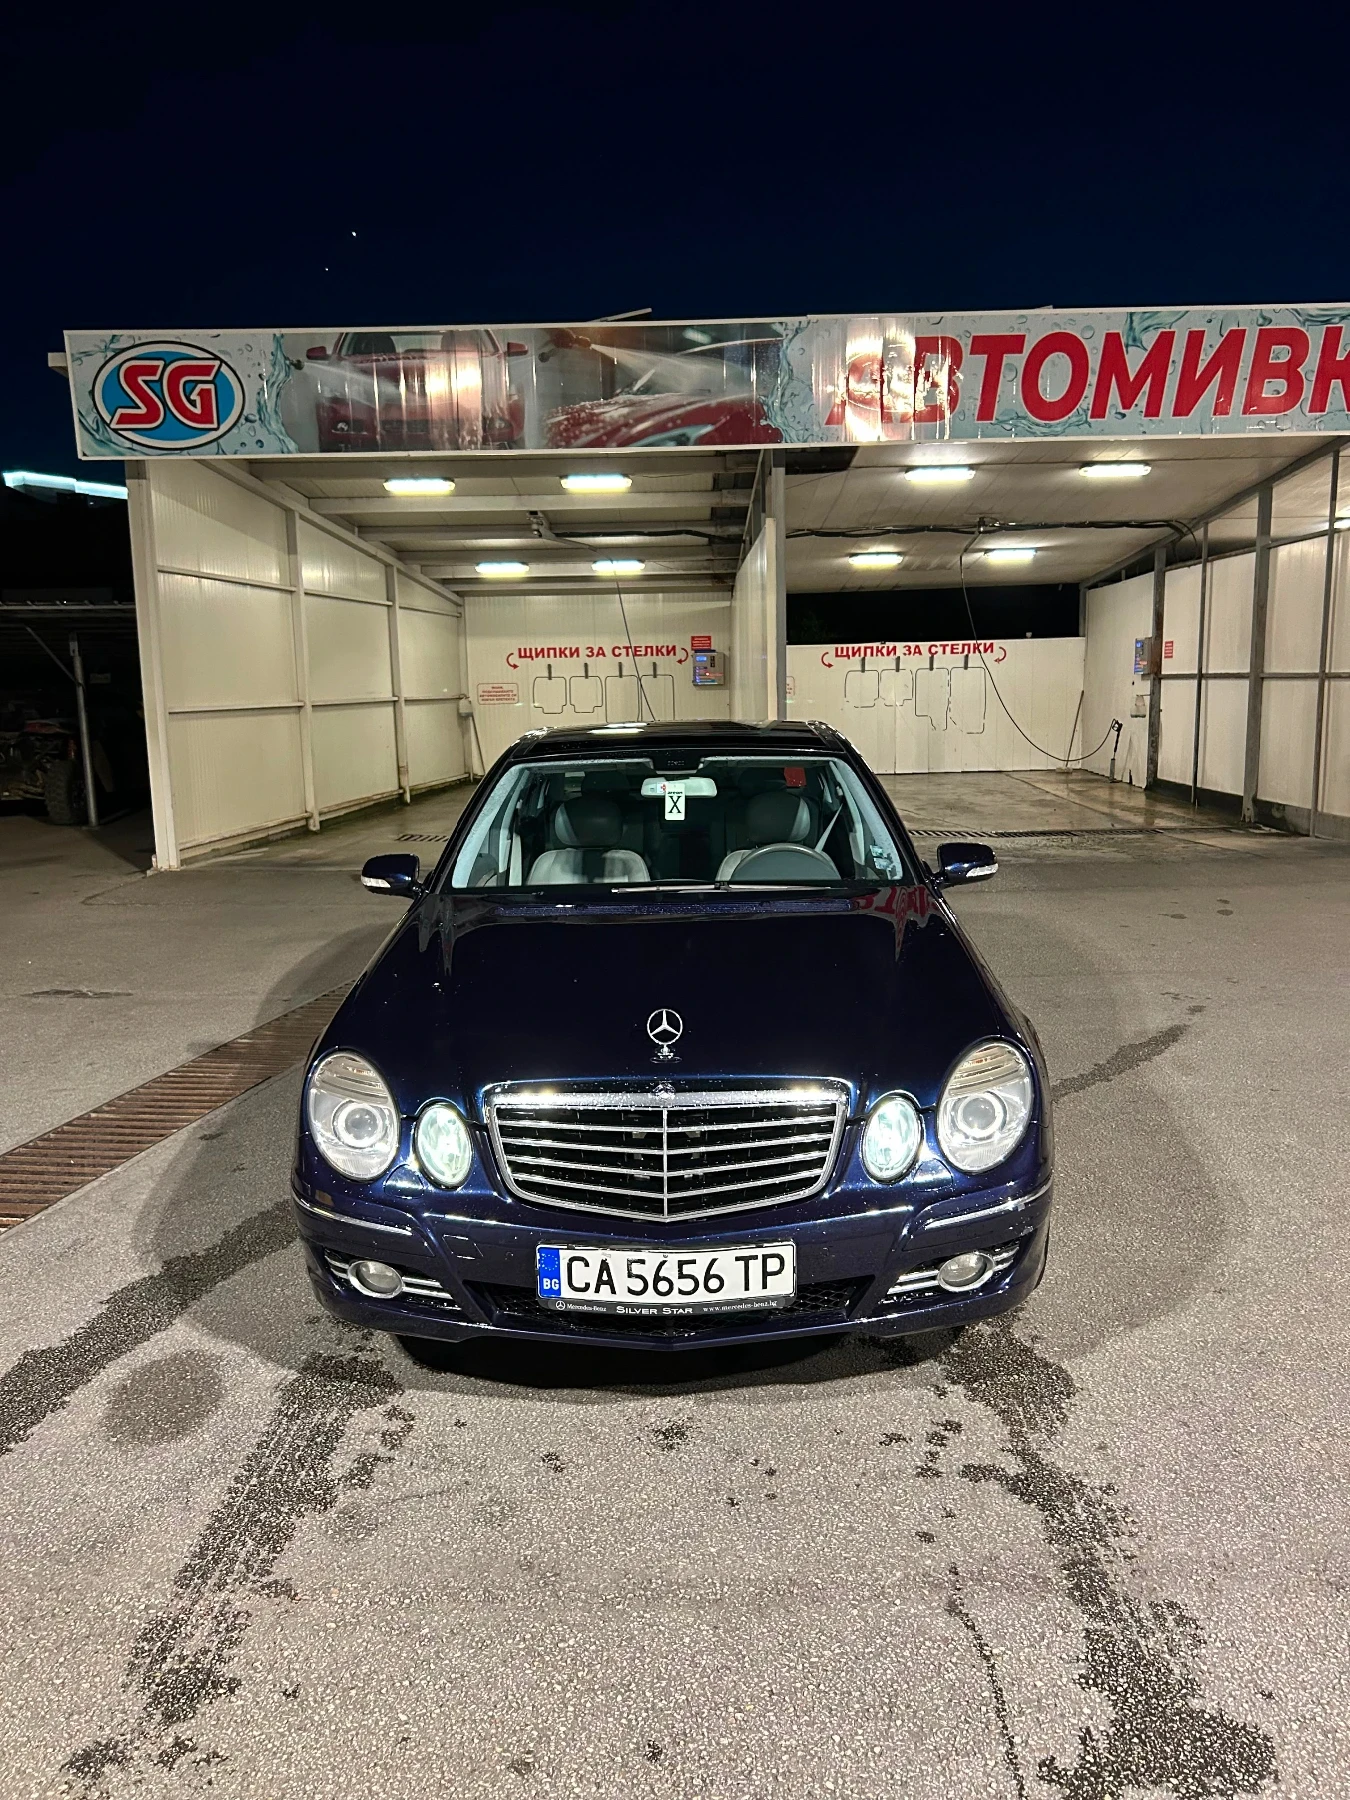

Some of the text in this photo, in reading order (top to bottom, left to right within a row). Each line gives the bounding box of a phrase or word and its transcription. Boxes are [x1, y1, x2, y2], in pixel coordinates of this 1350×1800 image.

[110, 359, 221, 430] SG
[518, 645, 677, 661] ЩИПКИ ЗА СТЕЛКИ
[834, 642, 994, 660] ЩИПКИ ЗА СТЕЛКИ
[668, 795, 682, 814] X
[566, 1253, 785, 1297] CA 5656 TP
[543, 1278, 560, 1291] BG
[566, 1303, 607, 1312] Mercedes-Benz
[703, 1300, 778, 1312] www.mercedes-benz.bg
